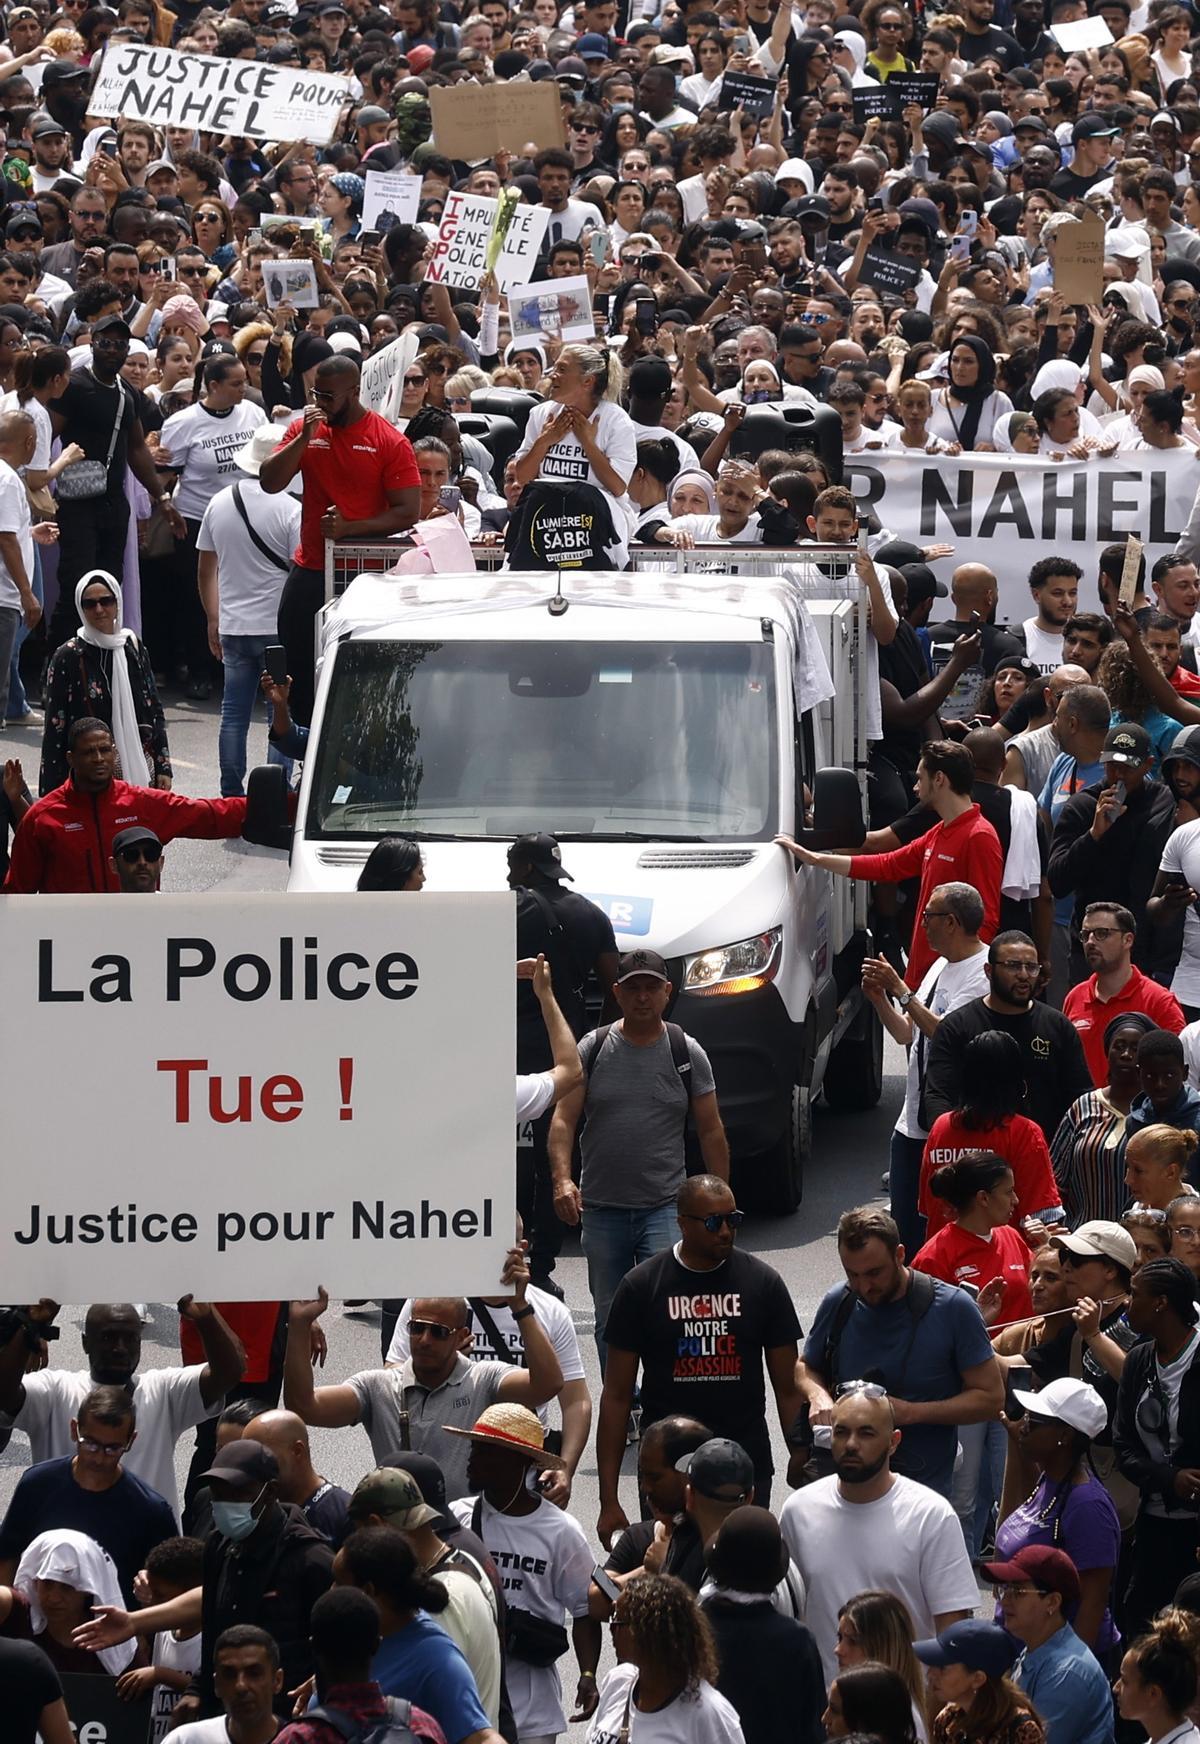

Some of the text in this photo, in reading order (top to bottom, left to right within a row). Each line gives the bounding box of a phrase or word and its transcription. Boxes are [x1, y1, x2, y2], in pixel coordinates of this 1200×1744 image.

[288, 82, 346, 106] POUR
[118, 79, 266, 135] NAHEL
[864, 107, 887, 115] POLICE
[445, 196, 533, 232] IMPUTÉ
[439, 220, 529, 256] GÉNÉLE
[873, 271, 899, 285] POLICE
[202, 433, 235, 449] JUSTICE
[217, 462, 241, 474] 27/0
[544, 458, 586, 478] NAHEL
[920, 468, 1183, 544] NAHEL
[543, 531, 590, 549] SABRI
[38, 936, 420, 1002] La Police
[156, 1057, 353, 1123] Tue !
[14, 1198, 493, 1252] Justice pour Nahel
[668, 1293, 742, 1320] URGENCE
[684, 1320, 728, 1338] NOTRE
[677, 1336, 736, 1356] POLICE
[673, 1356, 742, 1376] ASSASSINE
